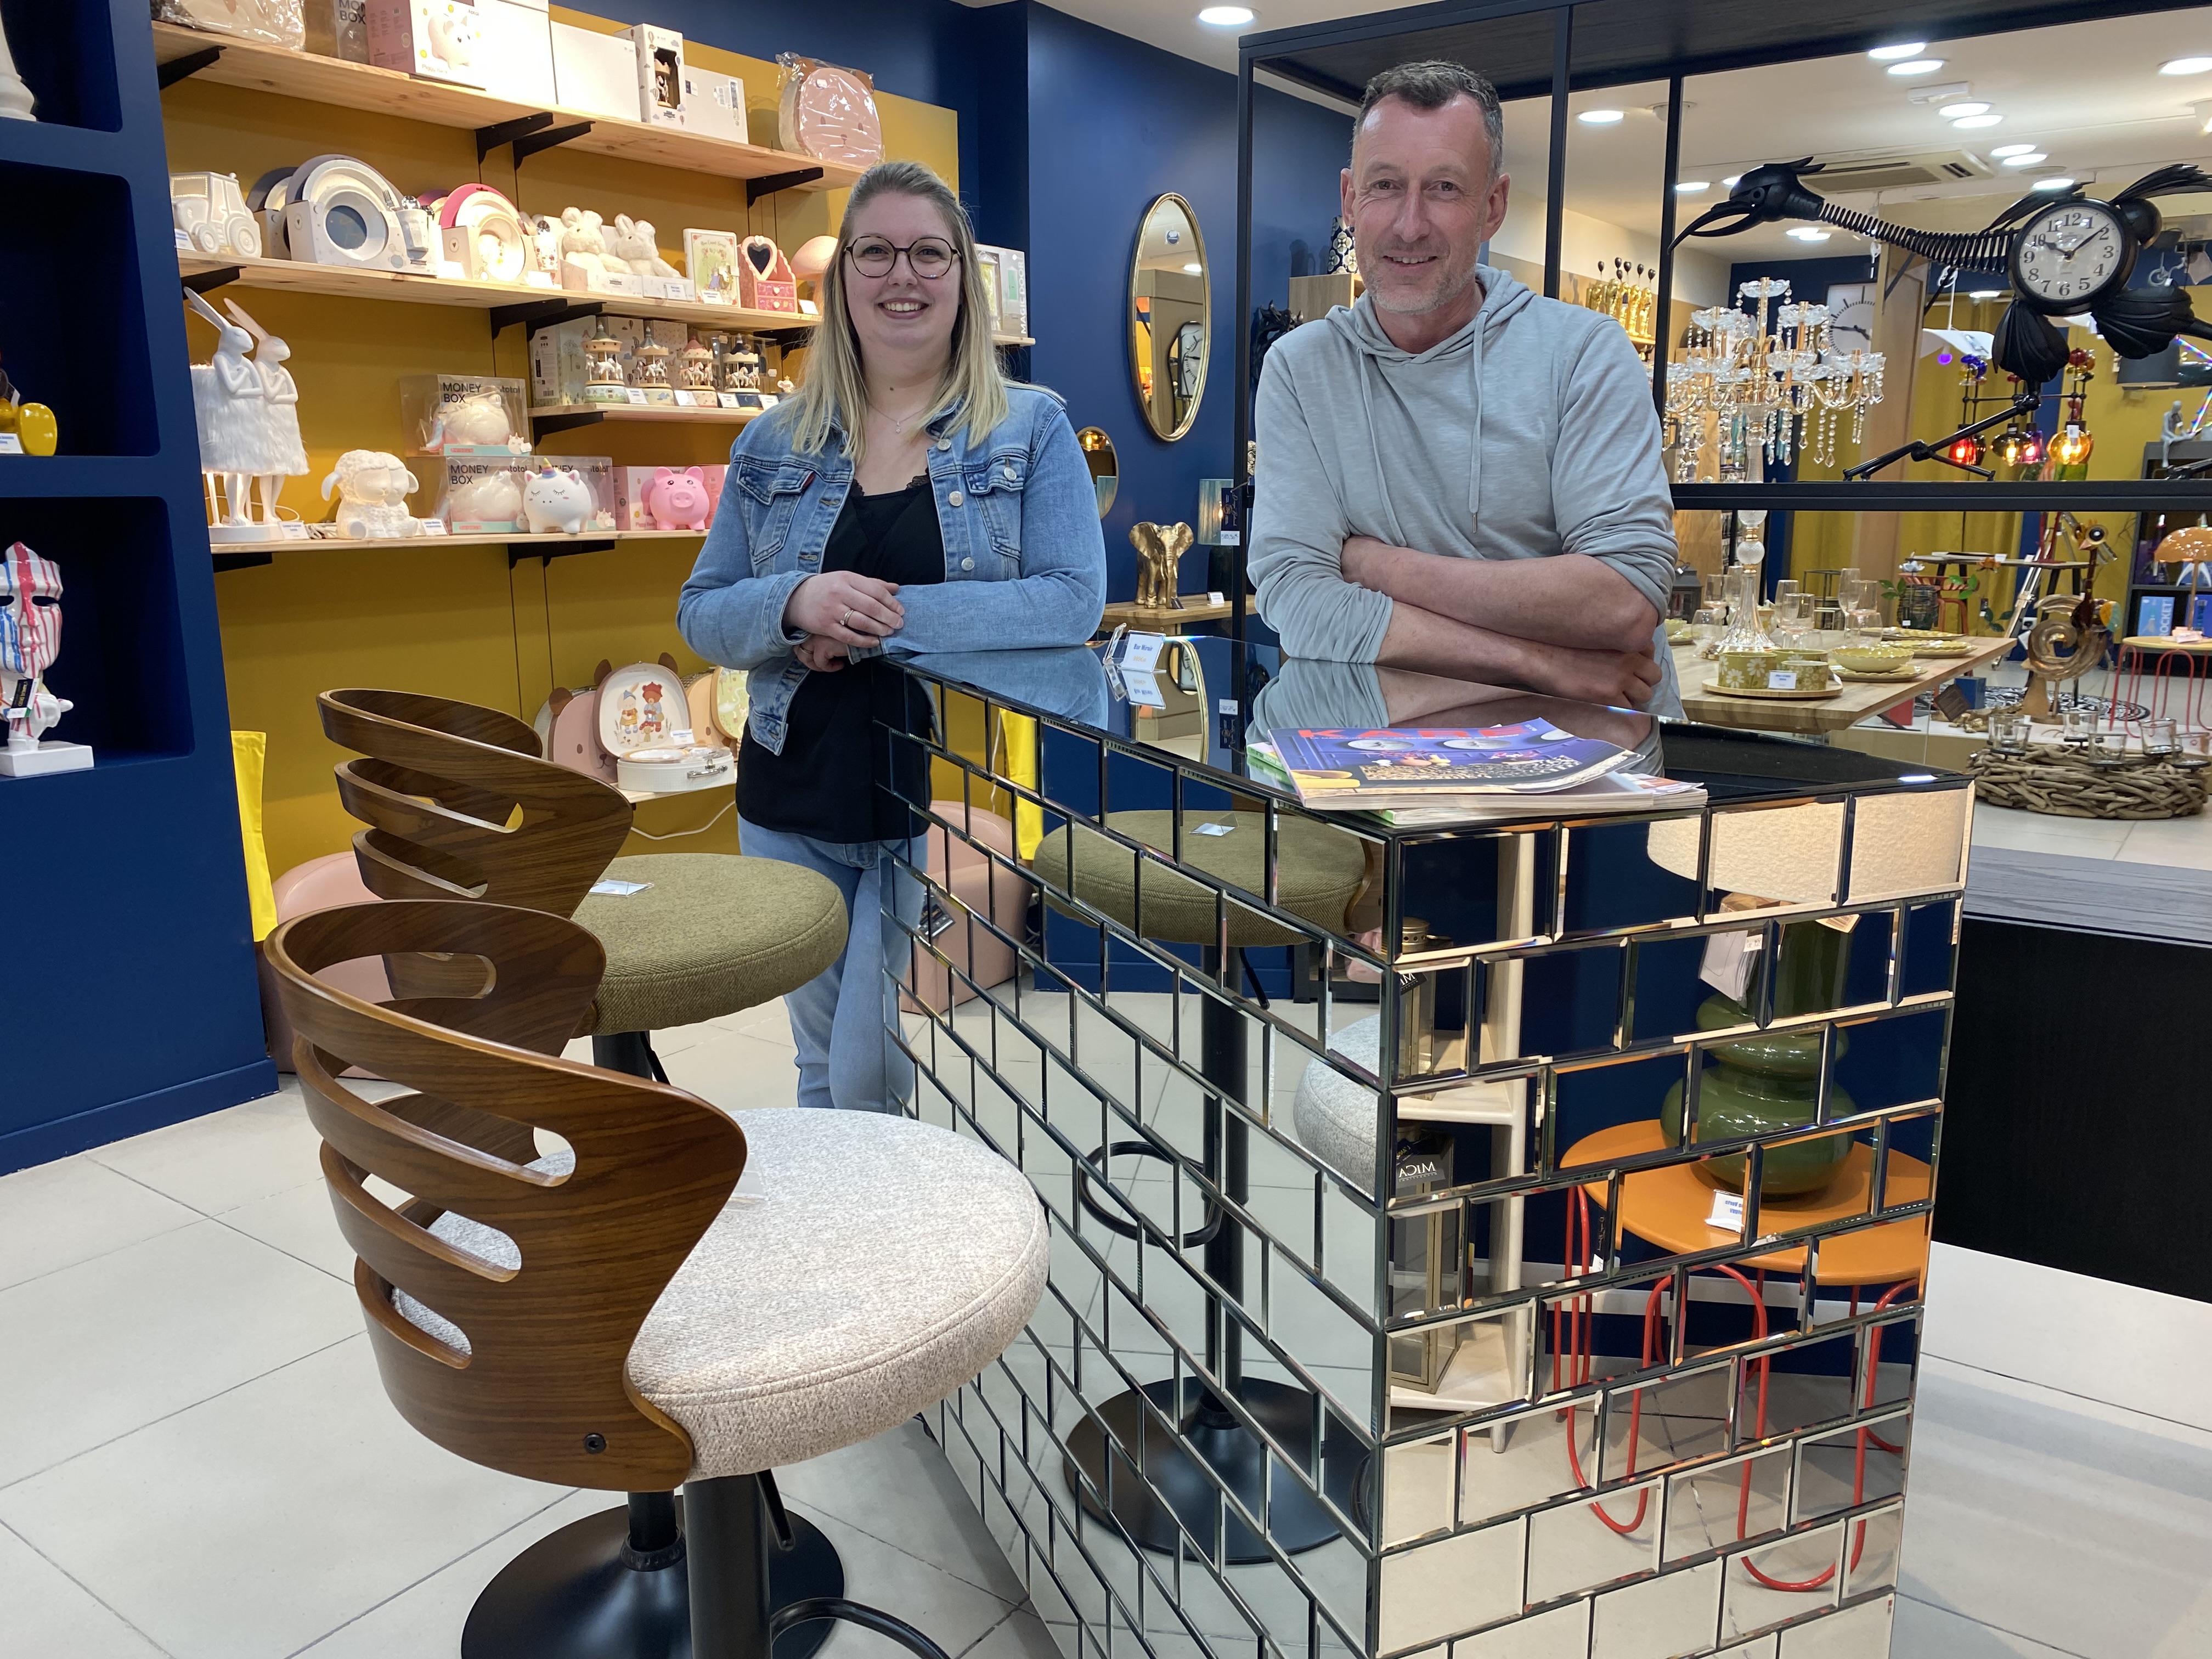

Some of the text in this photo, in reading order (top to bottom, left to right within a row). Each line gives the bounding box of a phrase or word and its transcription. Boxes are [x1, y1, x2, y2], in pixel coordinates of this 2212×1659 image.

[340, 10, 366, 25] BOX
[2047, 219, 2059, 232] 11
[2064, 213, 2081, 226] 12
[2086, 216, 2094, 229] 1
[2100, 227, 2109, 240] 2
[2033, 234, 2046, 246] 10
[2024, 251, 2035, 263] 9
[2103, 246, 2114, 258] 3
[2028, 268, 2039, 281] 8
[2094, 263, 2104, 276] 4
[2041, 280, 2051, 292] 7
[2059, 284, 2070, 296] 6
[2079, 278, 2090, 290] 5
[443, 382, 481, 393] MONEY
[444, 394, 466, 403] BOX
[450, 465, 488, 474] MONEY
[539, 465, 573, 473] MNEY
[451, 475, 473, 484] BOX
